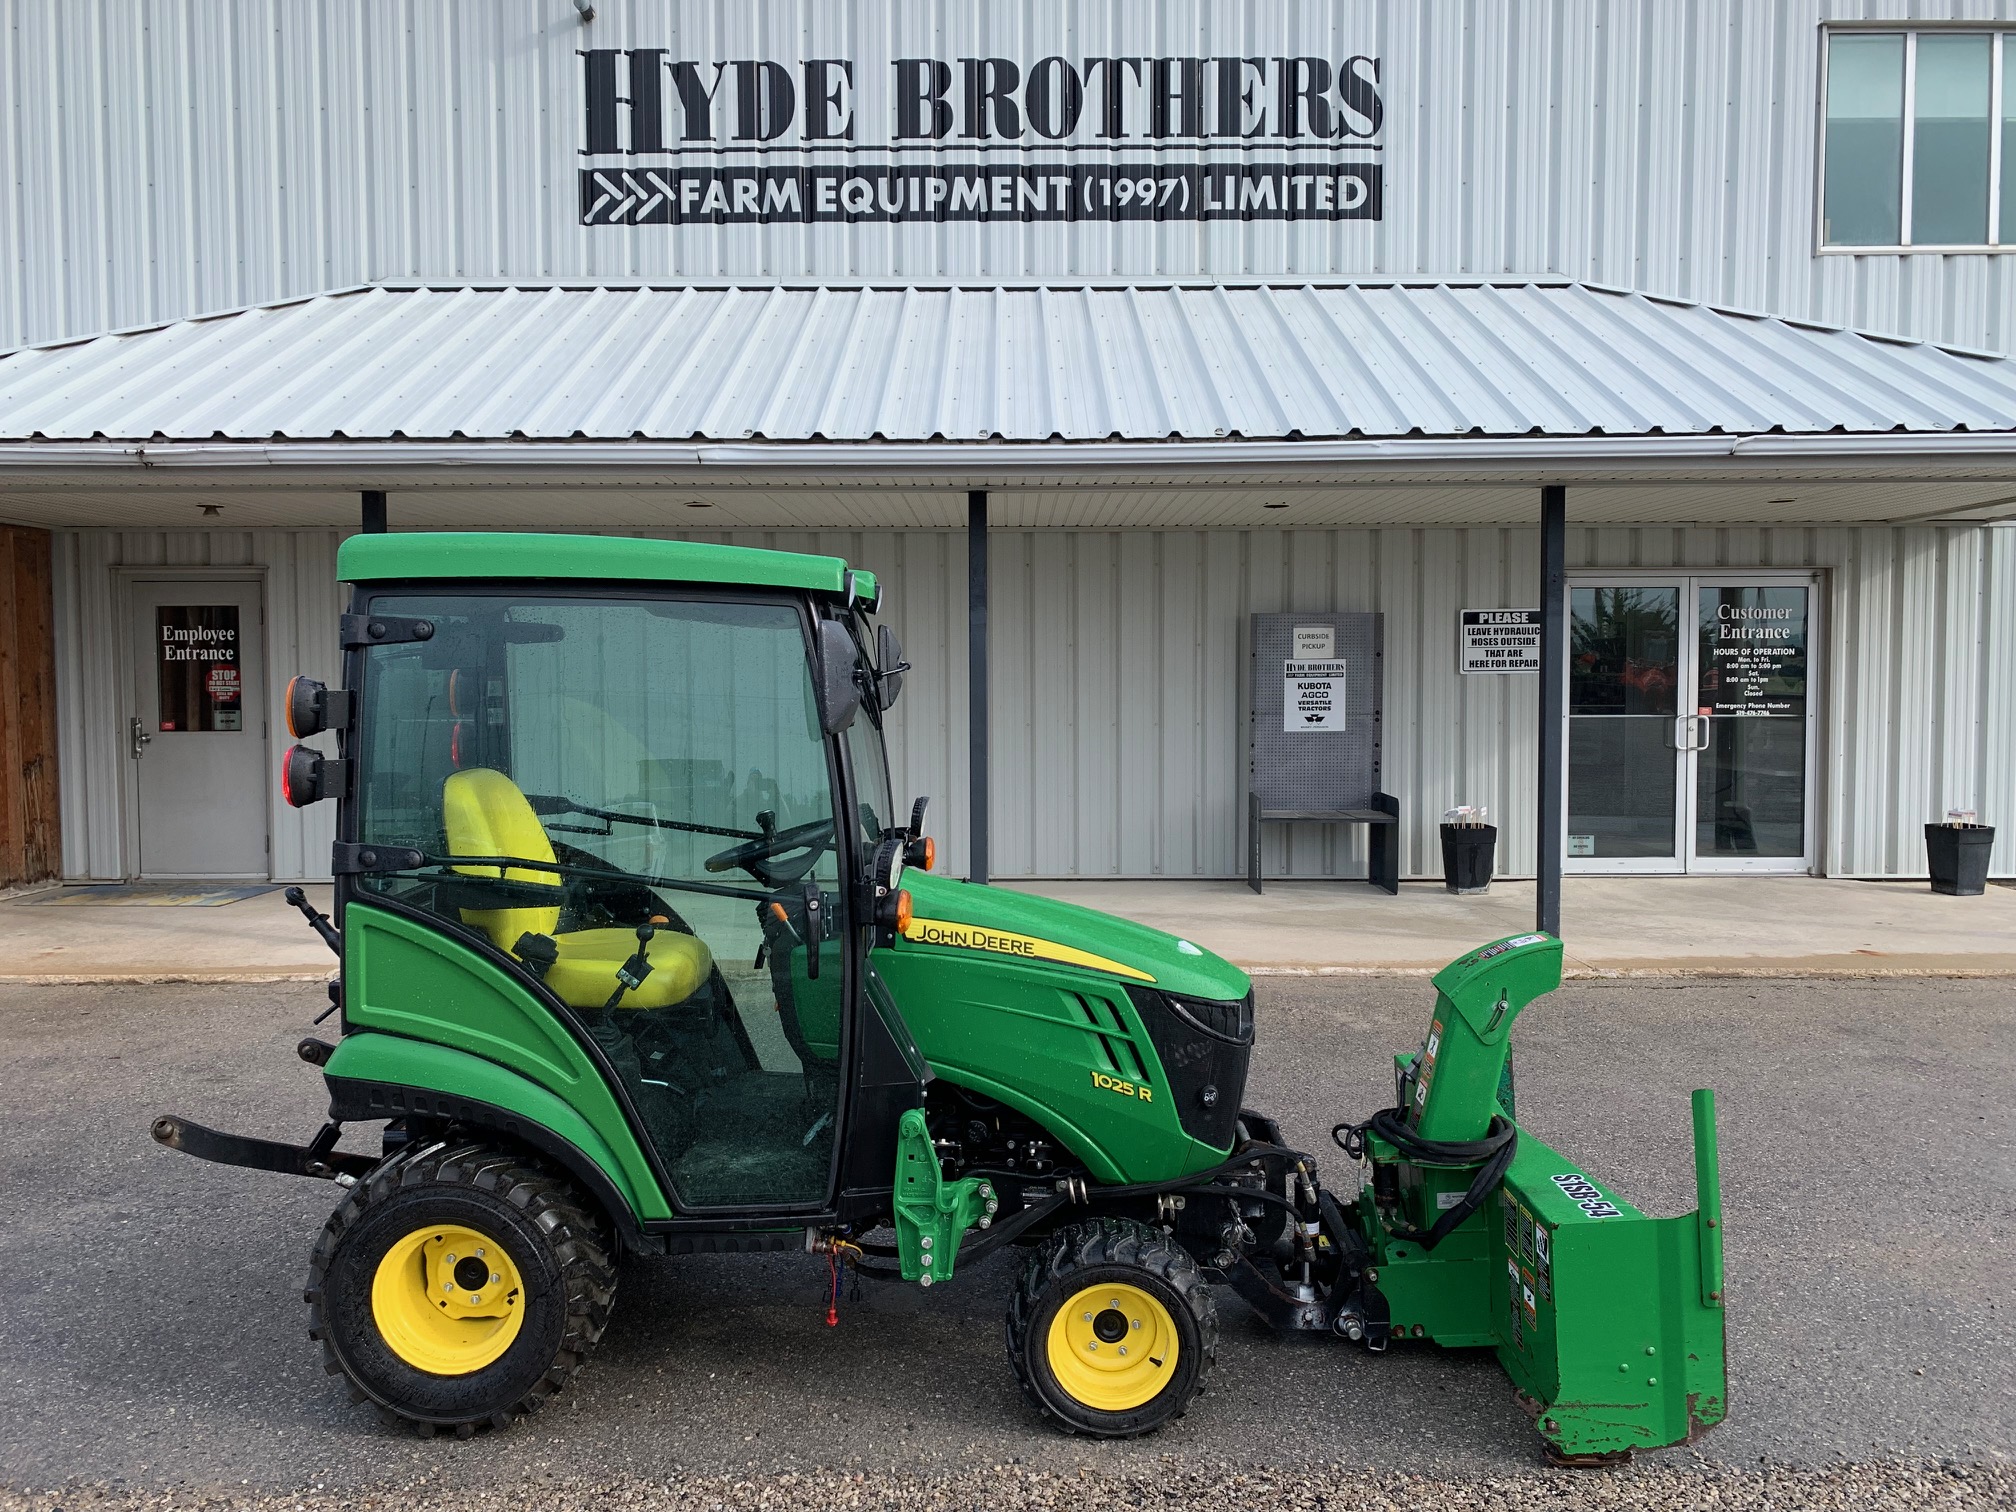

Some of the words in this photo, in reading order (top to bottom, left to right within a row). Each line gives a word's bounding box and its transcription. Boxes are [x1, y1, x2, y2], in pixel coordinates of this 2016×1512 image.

[576, 48, 854, 155] HYDE
[890, 55, 1384, 140] BROTHERS
[679, 176, 803, 214] FARM
[816, 175, 1069, 216] EQUIPMENT
[1083, 175, 1191, 210] (1997)
[1206, 175, 1368, 212] LIMITED
[1479, 612, 1529, 624] PLEASE
[1717, 604, 1793, 620] Customer
[162, 625, 235, 645] Employee
[1467, 628, 1491, 636] LEAVE
[1493, 627, 1540, 635] HYDRAULIC
[1720, 623, 1791, 639] Entrance
[1471, 638, 1498, 646] HOSES
[1500, 637, 1536, 645] OUTSIDE
[164, 645, 234, 661] Entrance
[1507, 649, 1523, 657] ARE
[1286, 663, 1306, 671] HYDE
[1308, 663, 1344, 671] BROTHERS
[1469, 660, 1489, 668] HERE
[1509, 659, 1538, 667] REPAIR
[212, 670, 236, 680] STOP
[1297, 682, 1332, 690] KUBOTA
[917, 925, 967, 946] JOHN
[972, 930, 1035, 955] DEERE
[1091, 1071, 1134, 1097] 1025
[1138, 1086, 1153, 1104] R
[1552, 1174, 1622, 1218] S1SB-54
